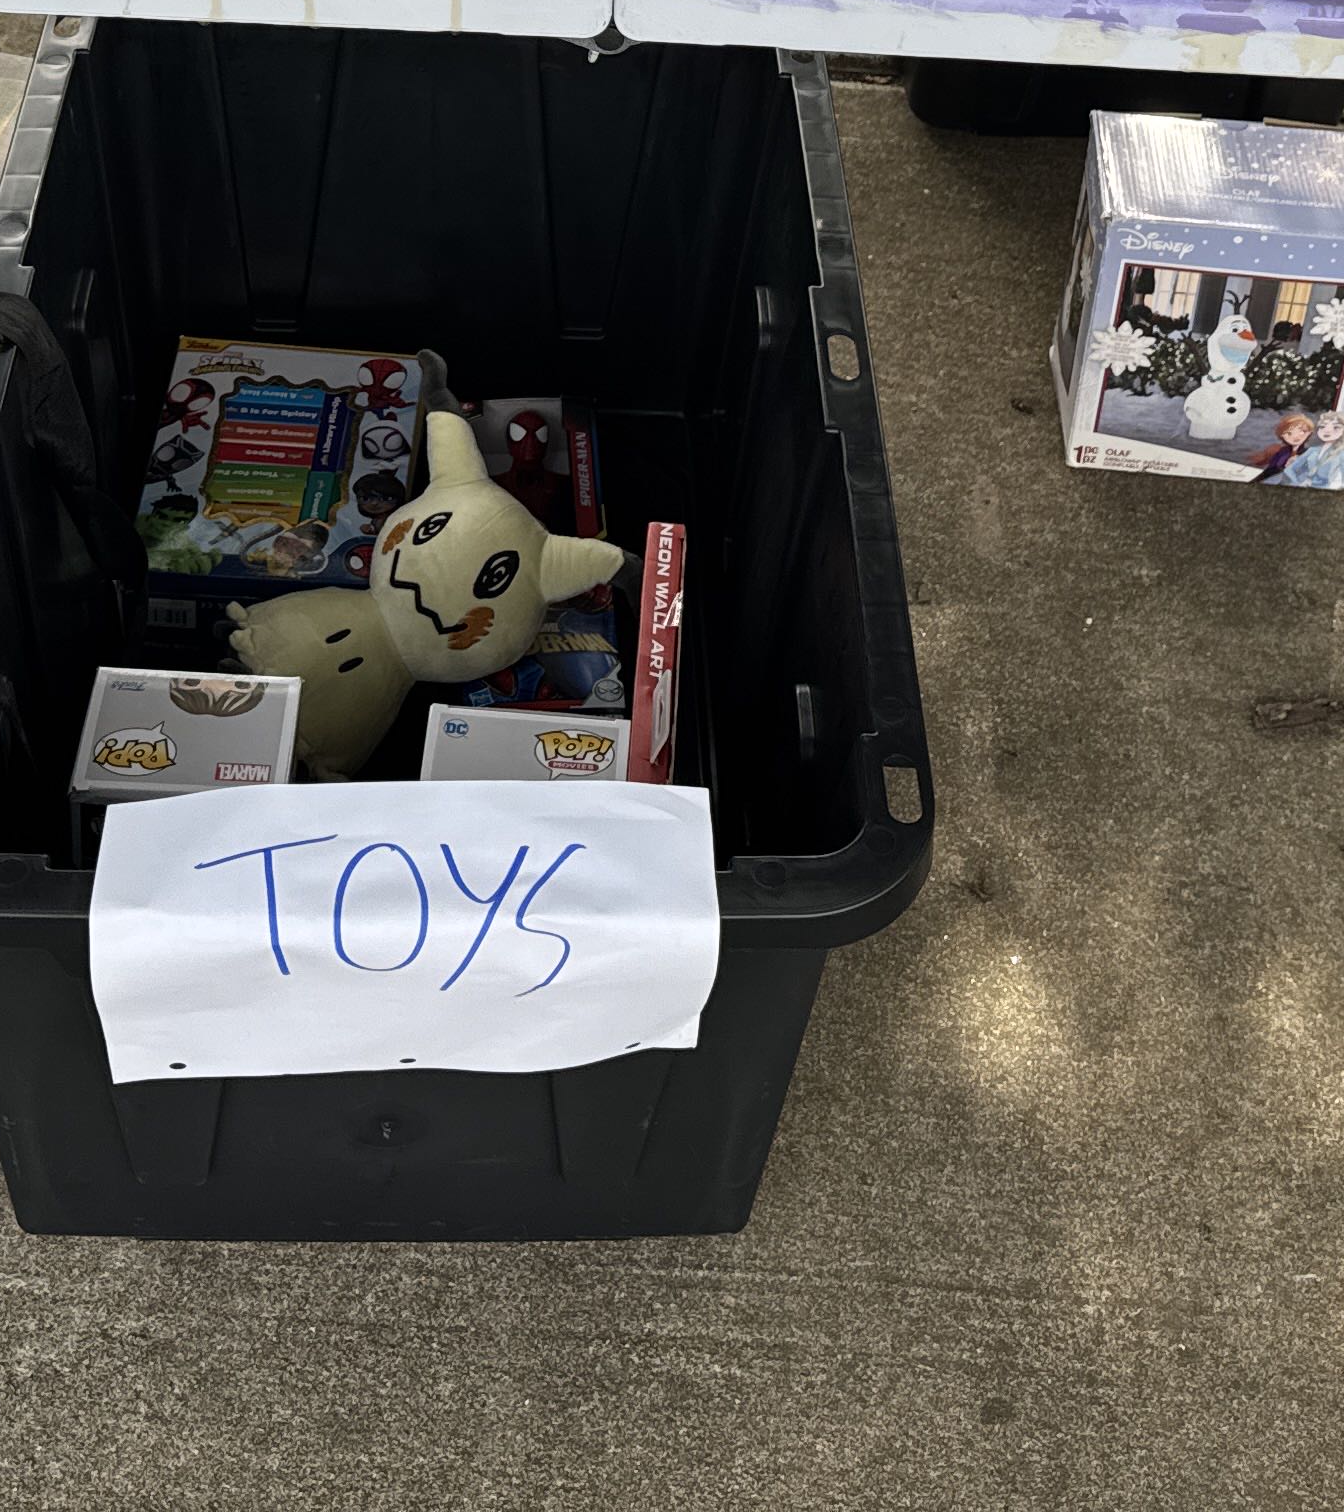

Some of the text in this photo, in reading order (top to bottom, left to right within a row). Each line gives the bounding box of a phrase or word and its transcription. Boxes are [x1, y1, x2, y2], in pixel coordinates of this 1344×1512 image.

[1116, 224, 1195, 261] Disney
[1105, 447, 1132, 457] OLAF
[574, 431, 592, 508] SPIDER-MAN
[648, 522, 675, 681] NEON WALL ART
[446, 722, 468, 736] DC
[92, 737, 176, 771] POP!
[534, 730, 615, 763] POP!
[216, 762, 271, 782] MARVEL
[549, 761, 595, 771] MOVIES
[194, 833, 588, 998] TOYS
